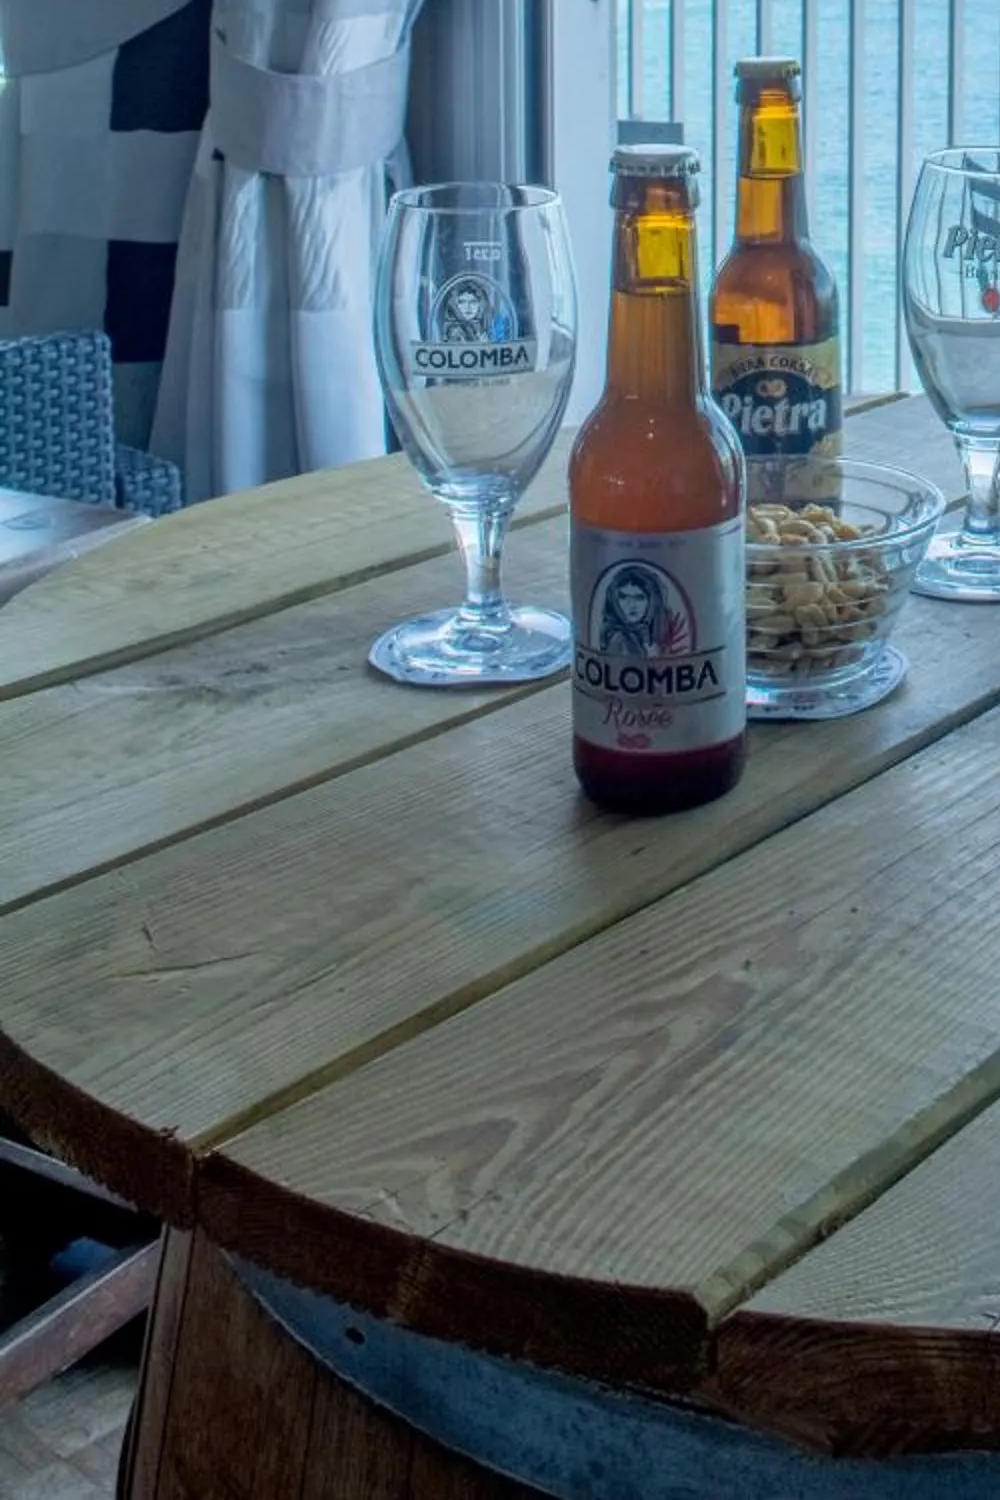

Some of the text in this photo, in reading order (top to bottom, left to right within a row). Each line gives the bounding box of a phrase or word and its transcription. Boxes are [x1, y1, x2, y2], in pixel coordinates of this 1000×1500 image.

[415, 344, 529, 369] COLOMBA
[721, 392, 828, 437] Pietra
[575, 651, 719, 694] COLOMBA
